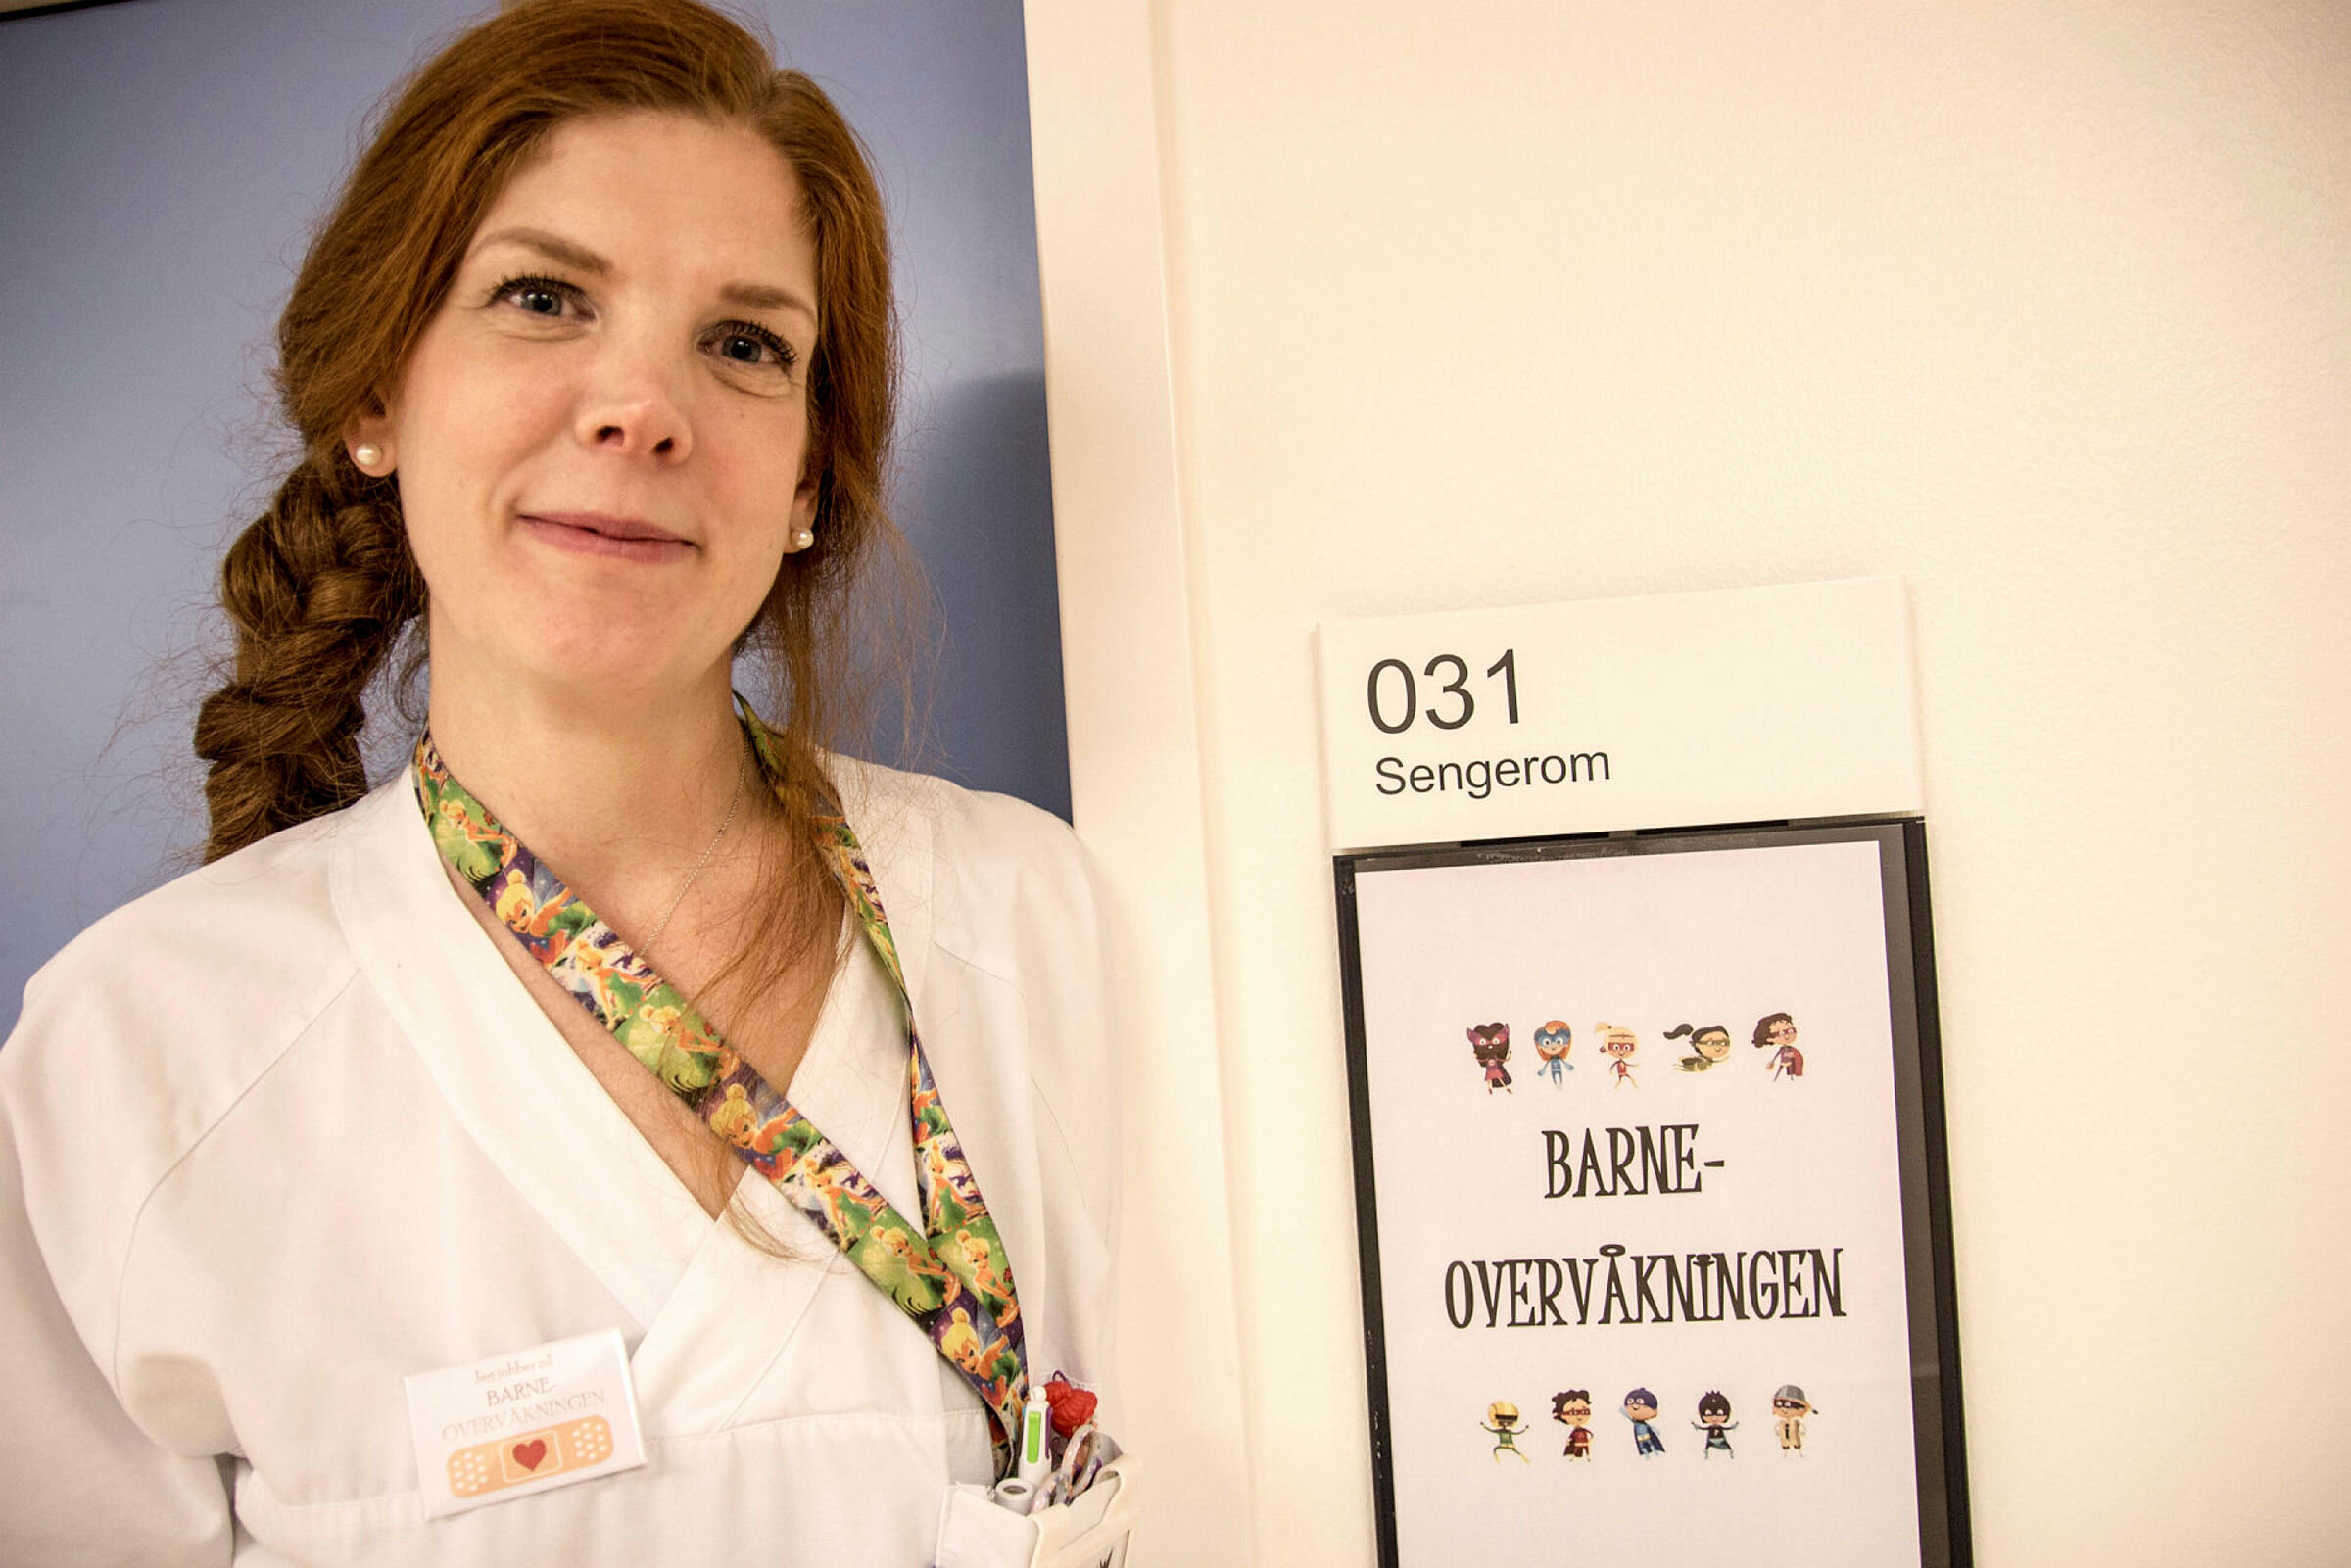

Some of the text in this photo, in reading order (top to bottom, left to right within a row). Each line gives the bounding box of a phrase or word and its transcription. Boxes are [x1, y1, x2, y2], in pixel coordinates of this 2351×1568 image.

[1367, 648, 1519, 735] 031
[1376, 751, 1610, 800] Sengerom
[1541, 1123, 1725, 1199] BARNE-
[1445, 1244, 1847, 1329] OVERVÅKNINGEN
